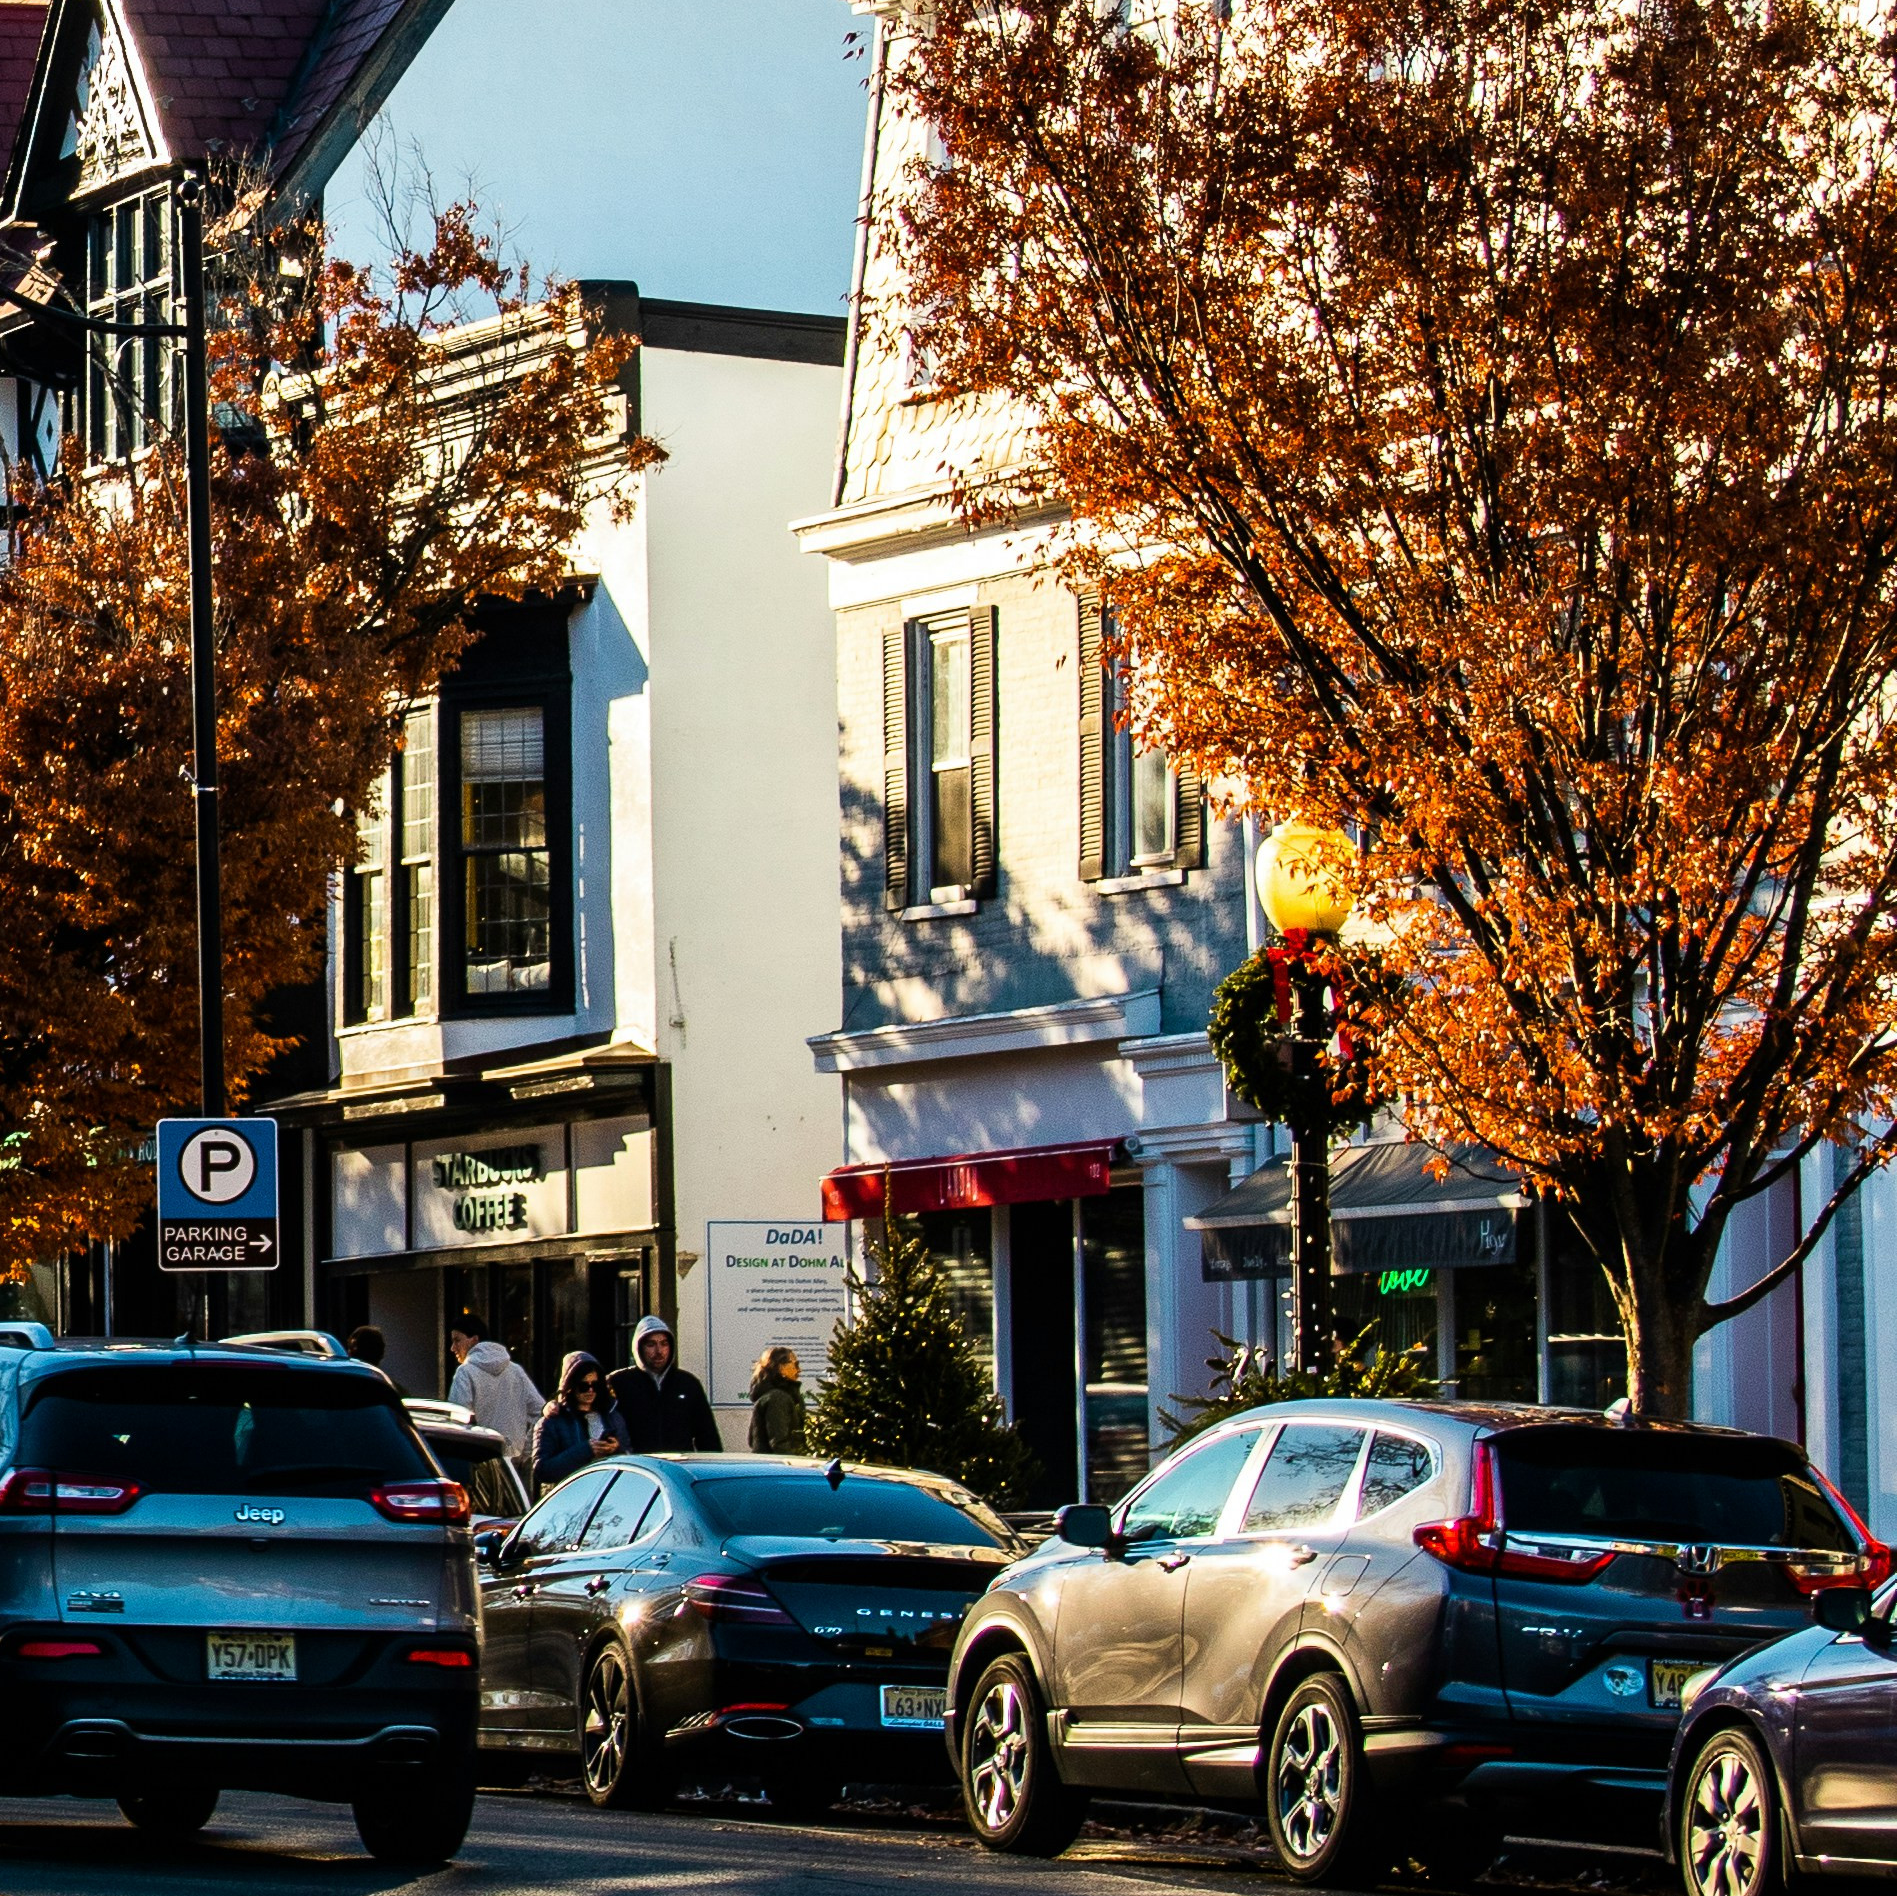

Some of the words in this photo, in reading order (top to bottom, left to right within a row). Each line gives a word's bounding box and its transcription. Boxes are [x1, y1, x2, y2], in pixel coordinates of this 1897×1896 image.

[200, 1141, 241, 1192] P
[432, 1145, 539, 1188] STARBUCKS
[452, 1193, 515, 1230] COFFEE
[164, 1227, 247, 1241] PARKING
[766, 1229, 823, 1244] DaDA!
[166, 1246, 245, 1261] GARAGE
[726, 1255, 769, 1268] DESIGN
[789, 1255, 827, 1268] DOHM
[236, 1505, 285, 1524] Jeep
